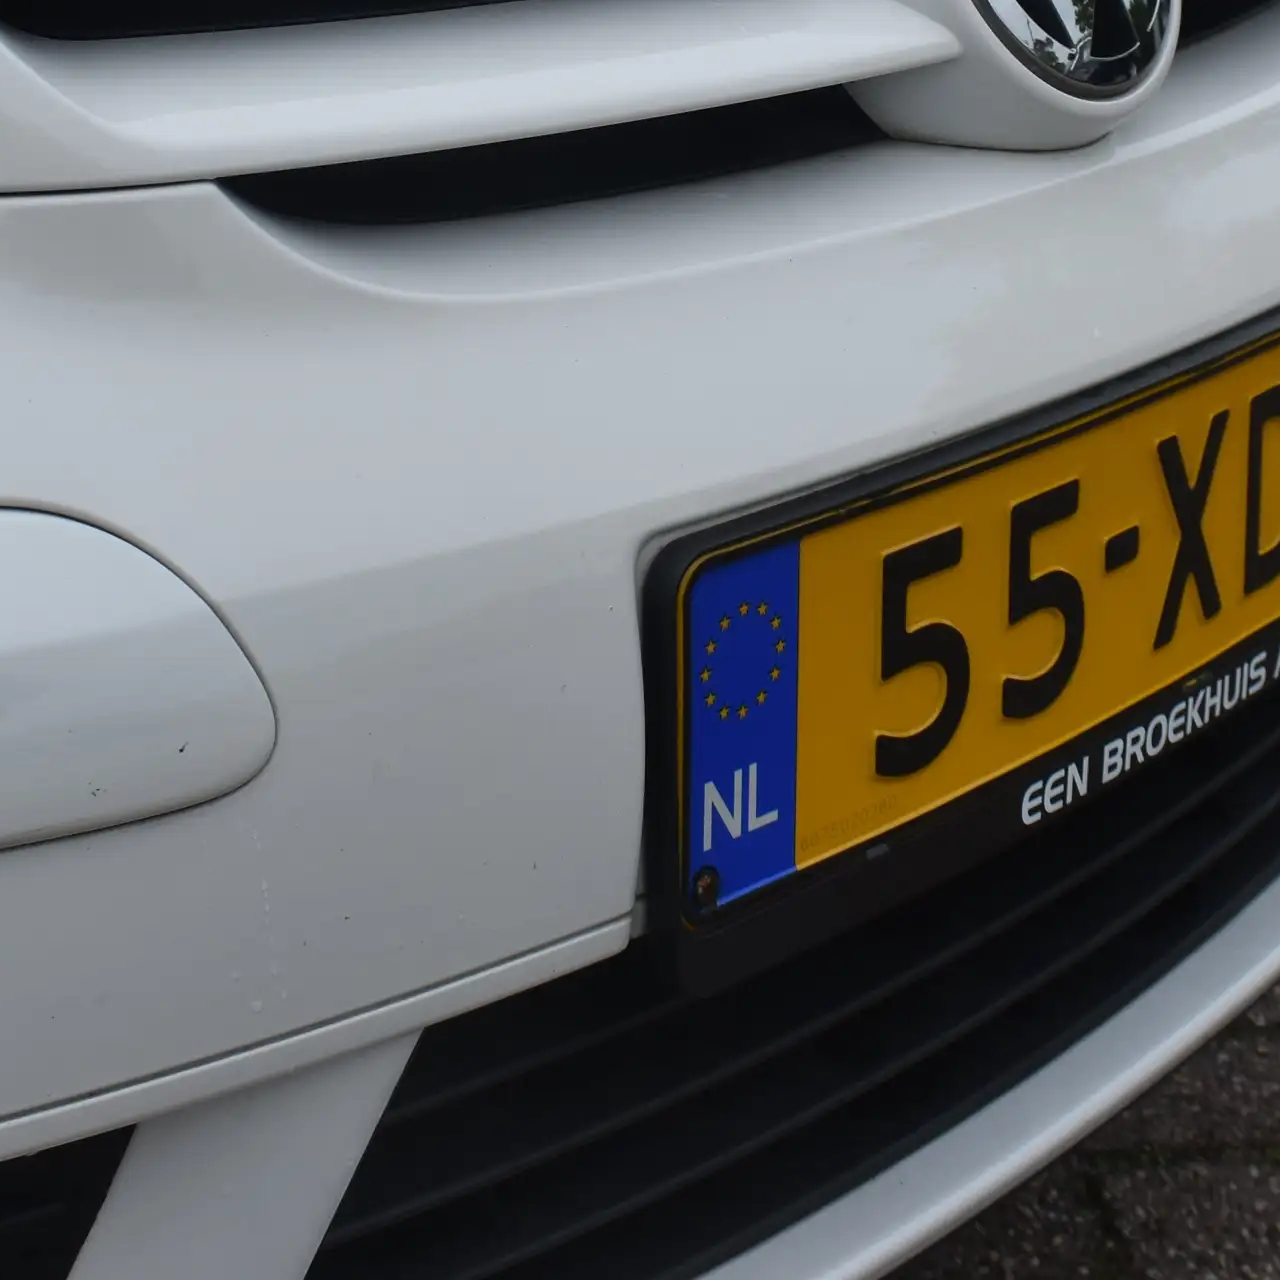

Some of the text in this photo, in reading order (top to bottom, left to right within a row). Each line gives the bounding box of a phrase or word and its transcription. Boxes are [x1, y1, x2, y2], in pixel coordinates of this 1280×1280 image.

[1021, 755, 1089, 825] EEN
[1102, 651, 1267, 784] BROEKHUIS
[703, 763, 779, 852] NL
